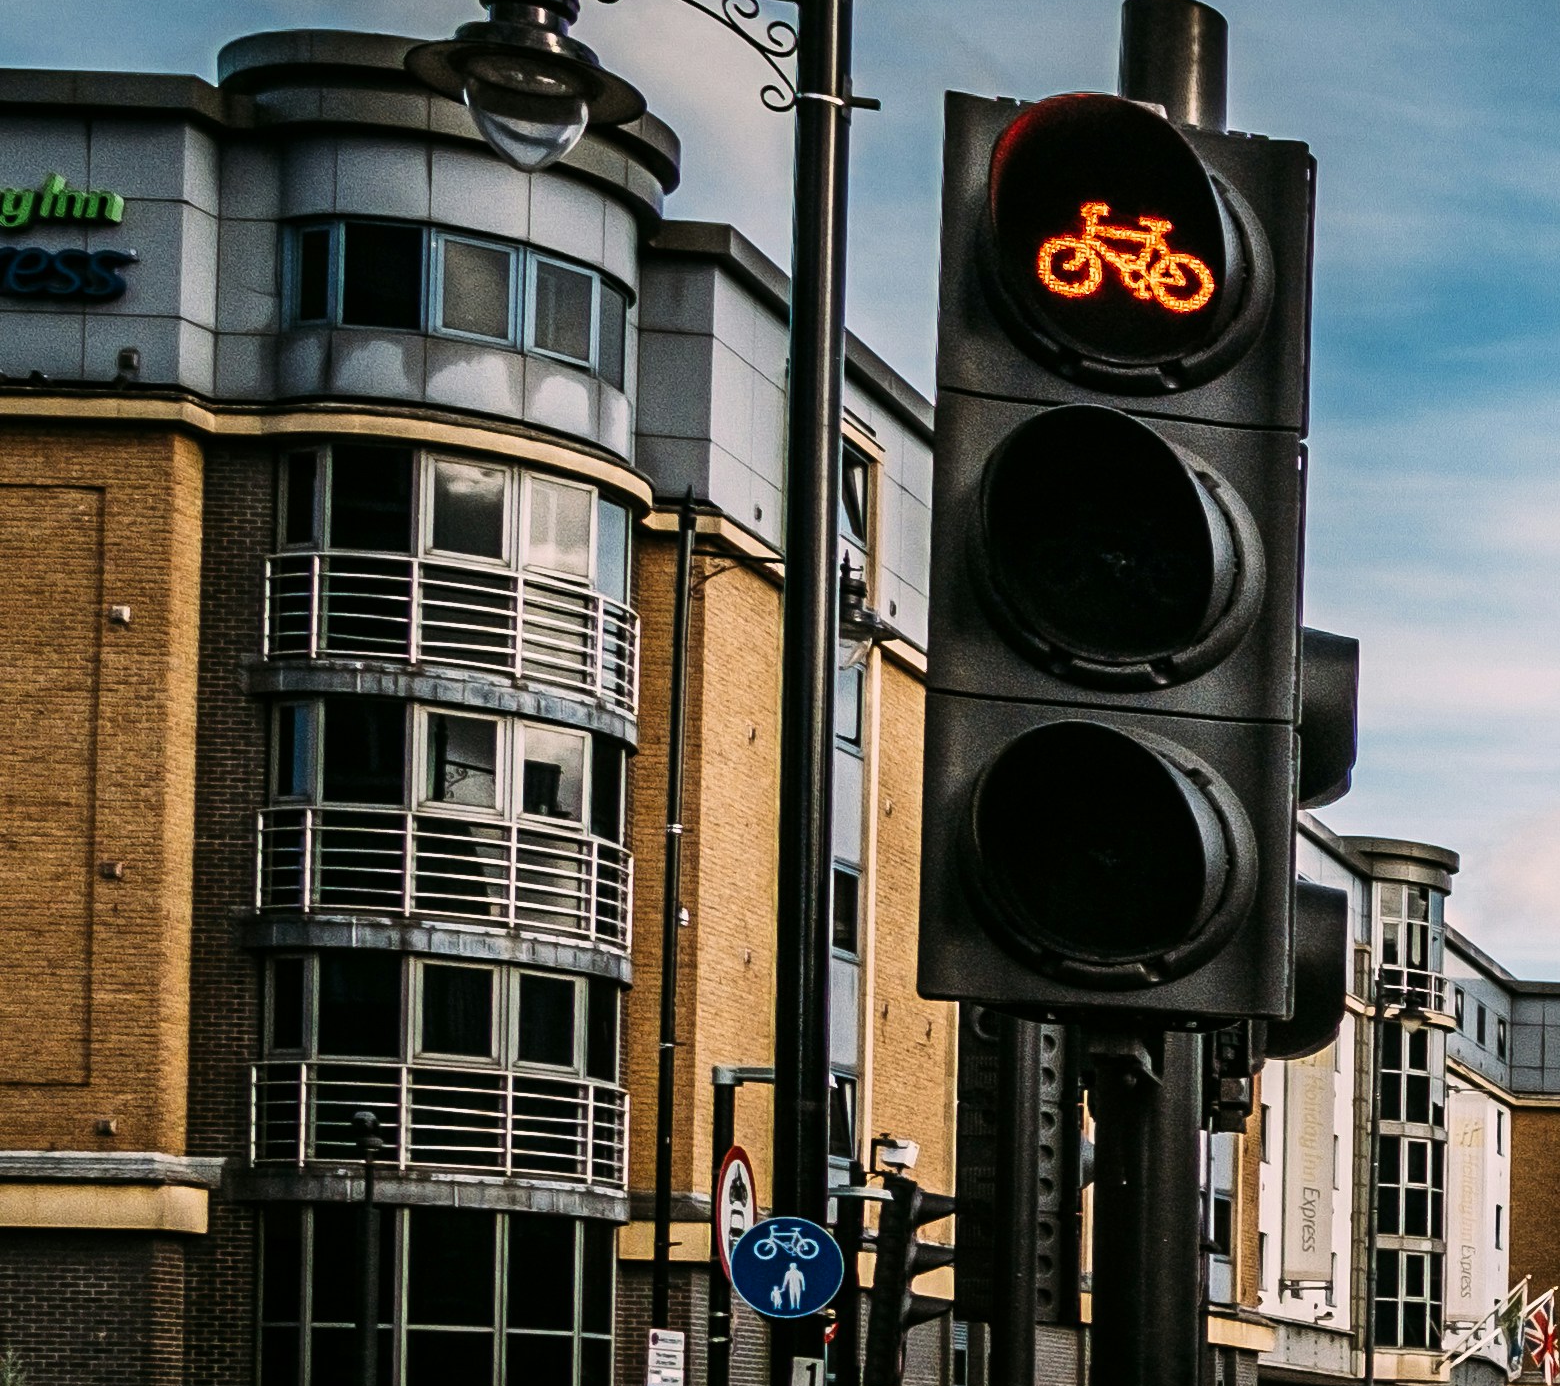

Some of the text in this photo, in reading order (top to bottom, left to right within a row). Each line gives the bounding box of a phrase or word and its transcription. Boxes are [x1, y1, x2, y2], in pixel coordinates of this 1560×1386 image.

[39, 172, 124, 222] Inn
[1299, 1186, 1321, 1254] Express
[1459, 1244, 1476, 1300] Express
